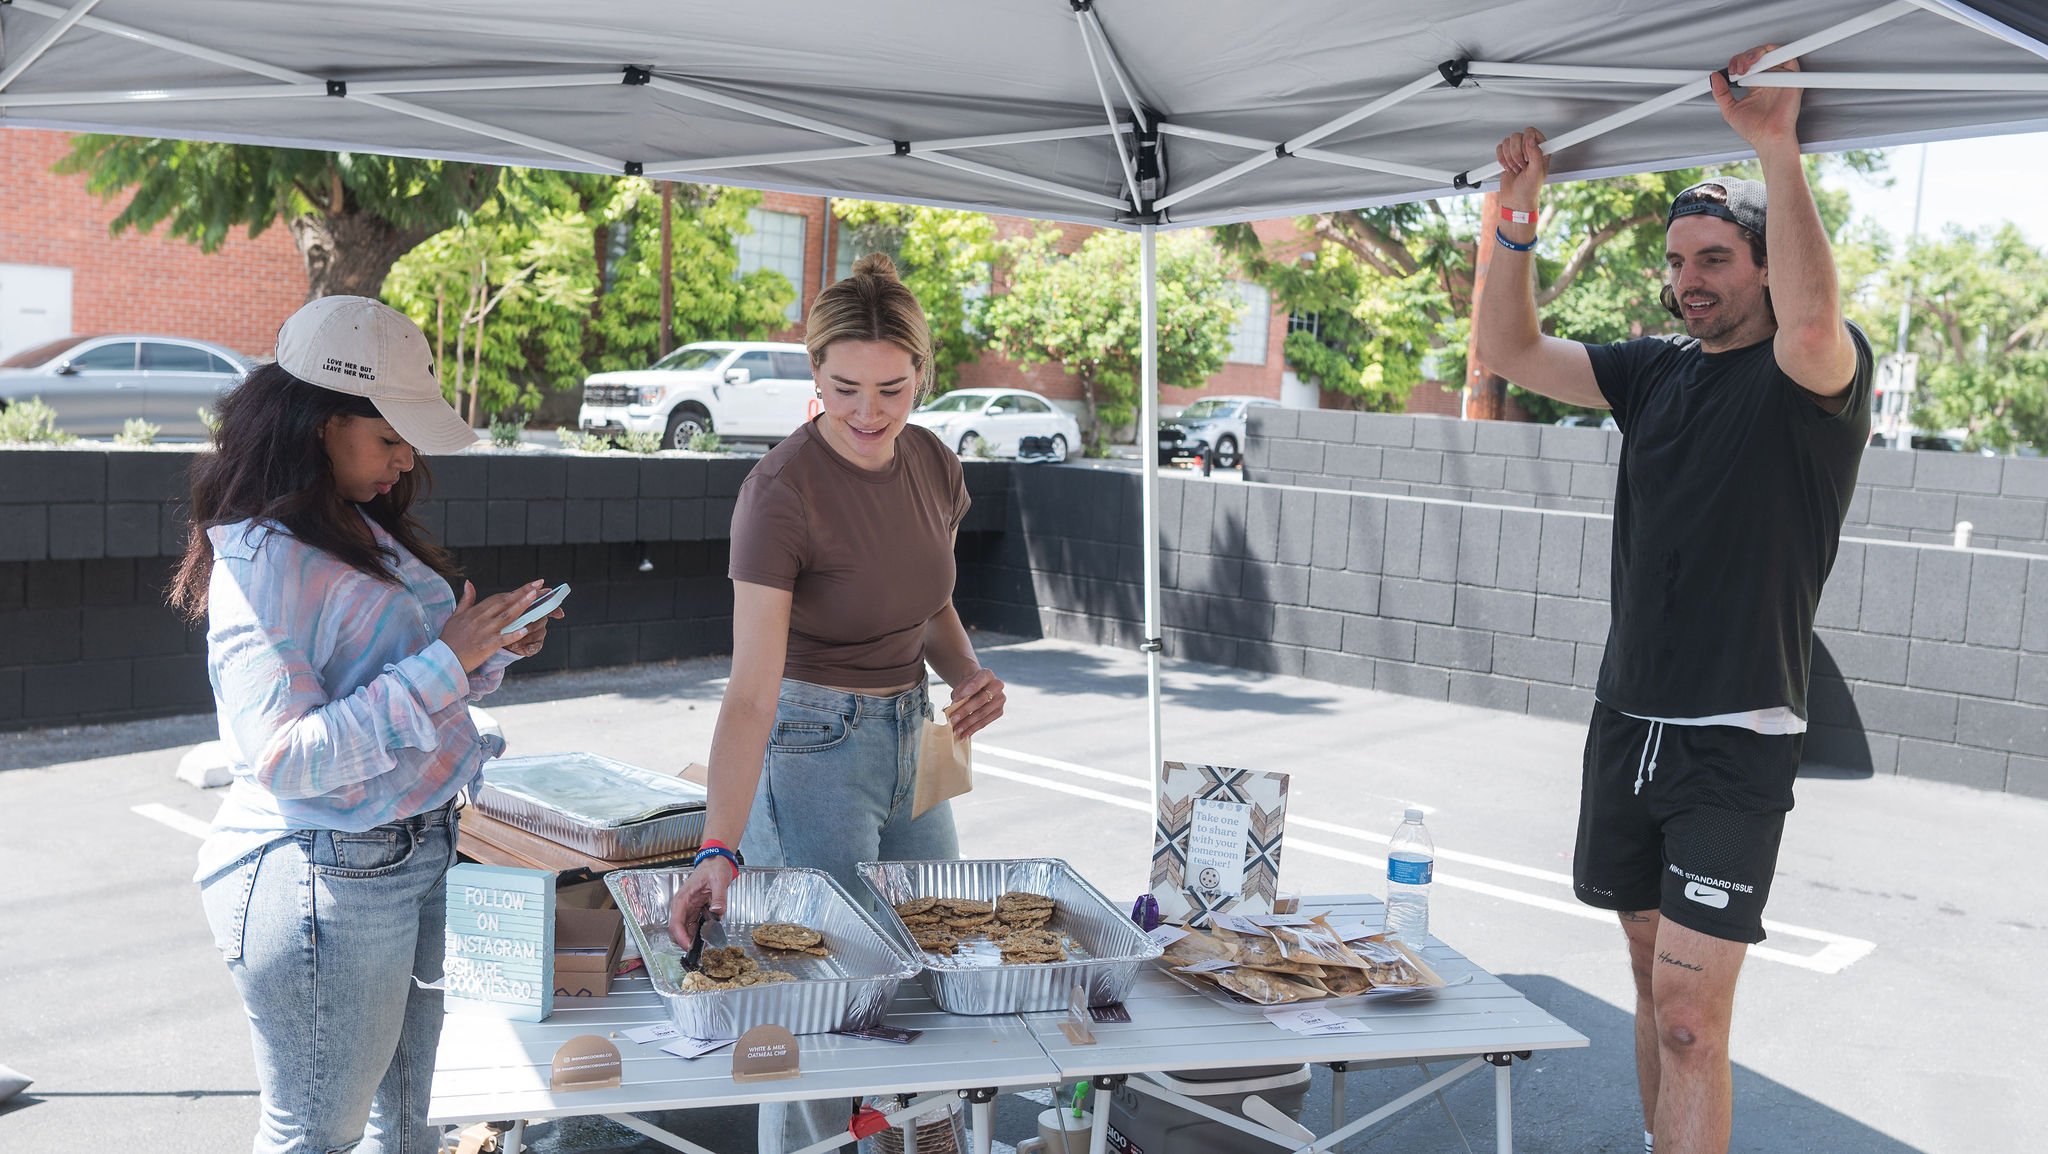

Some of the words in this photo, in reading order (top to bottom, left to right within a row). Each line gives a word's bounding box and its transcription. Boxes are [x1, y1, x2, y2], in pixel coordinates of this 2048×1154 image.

[322, 364, 342, 373] LEAVE
[359, 372, 375, 380] WILD
[327, 358, 342, 366] LOVE
[344, 362, 358, 370] HER
[360, 365, 372, 373] BUT
[1195, 811, 1219, 823] Take
[1220, 817, 1240, 826] one
[1197, 825, 1208, 833] to
[1209, 826, 1238, 838] share
[1192, 834, 1214, 845] with
[1215, 838, 1239, 849] your
[1188, 844, 1239, 860] homeroom
[1193, 856, 1231, 869] teacher!
[1668, 863, 1684, 877] NIKE
[1685, 872, 1732, 889] STANDARD
[1732, 882, 1754, 894] ISSUE
[464, 887, 526, 911] FOLLOW
[477, 912, 500, 932] ON
[455, 934, 536, 960] INSTAGRAM
[442, 958, 504, 979] @SHARE
[747, 1051, 773, 1059] OATMEAL
